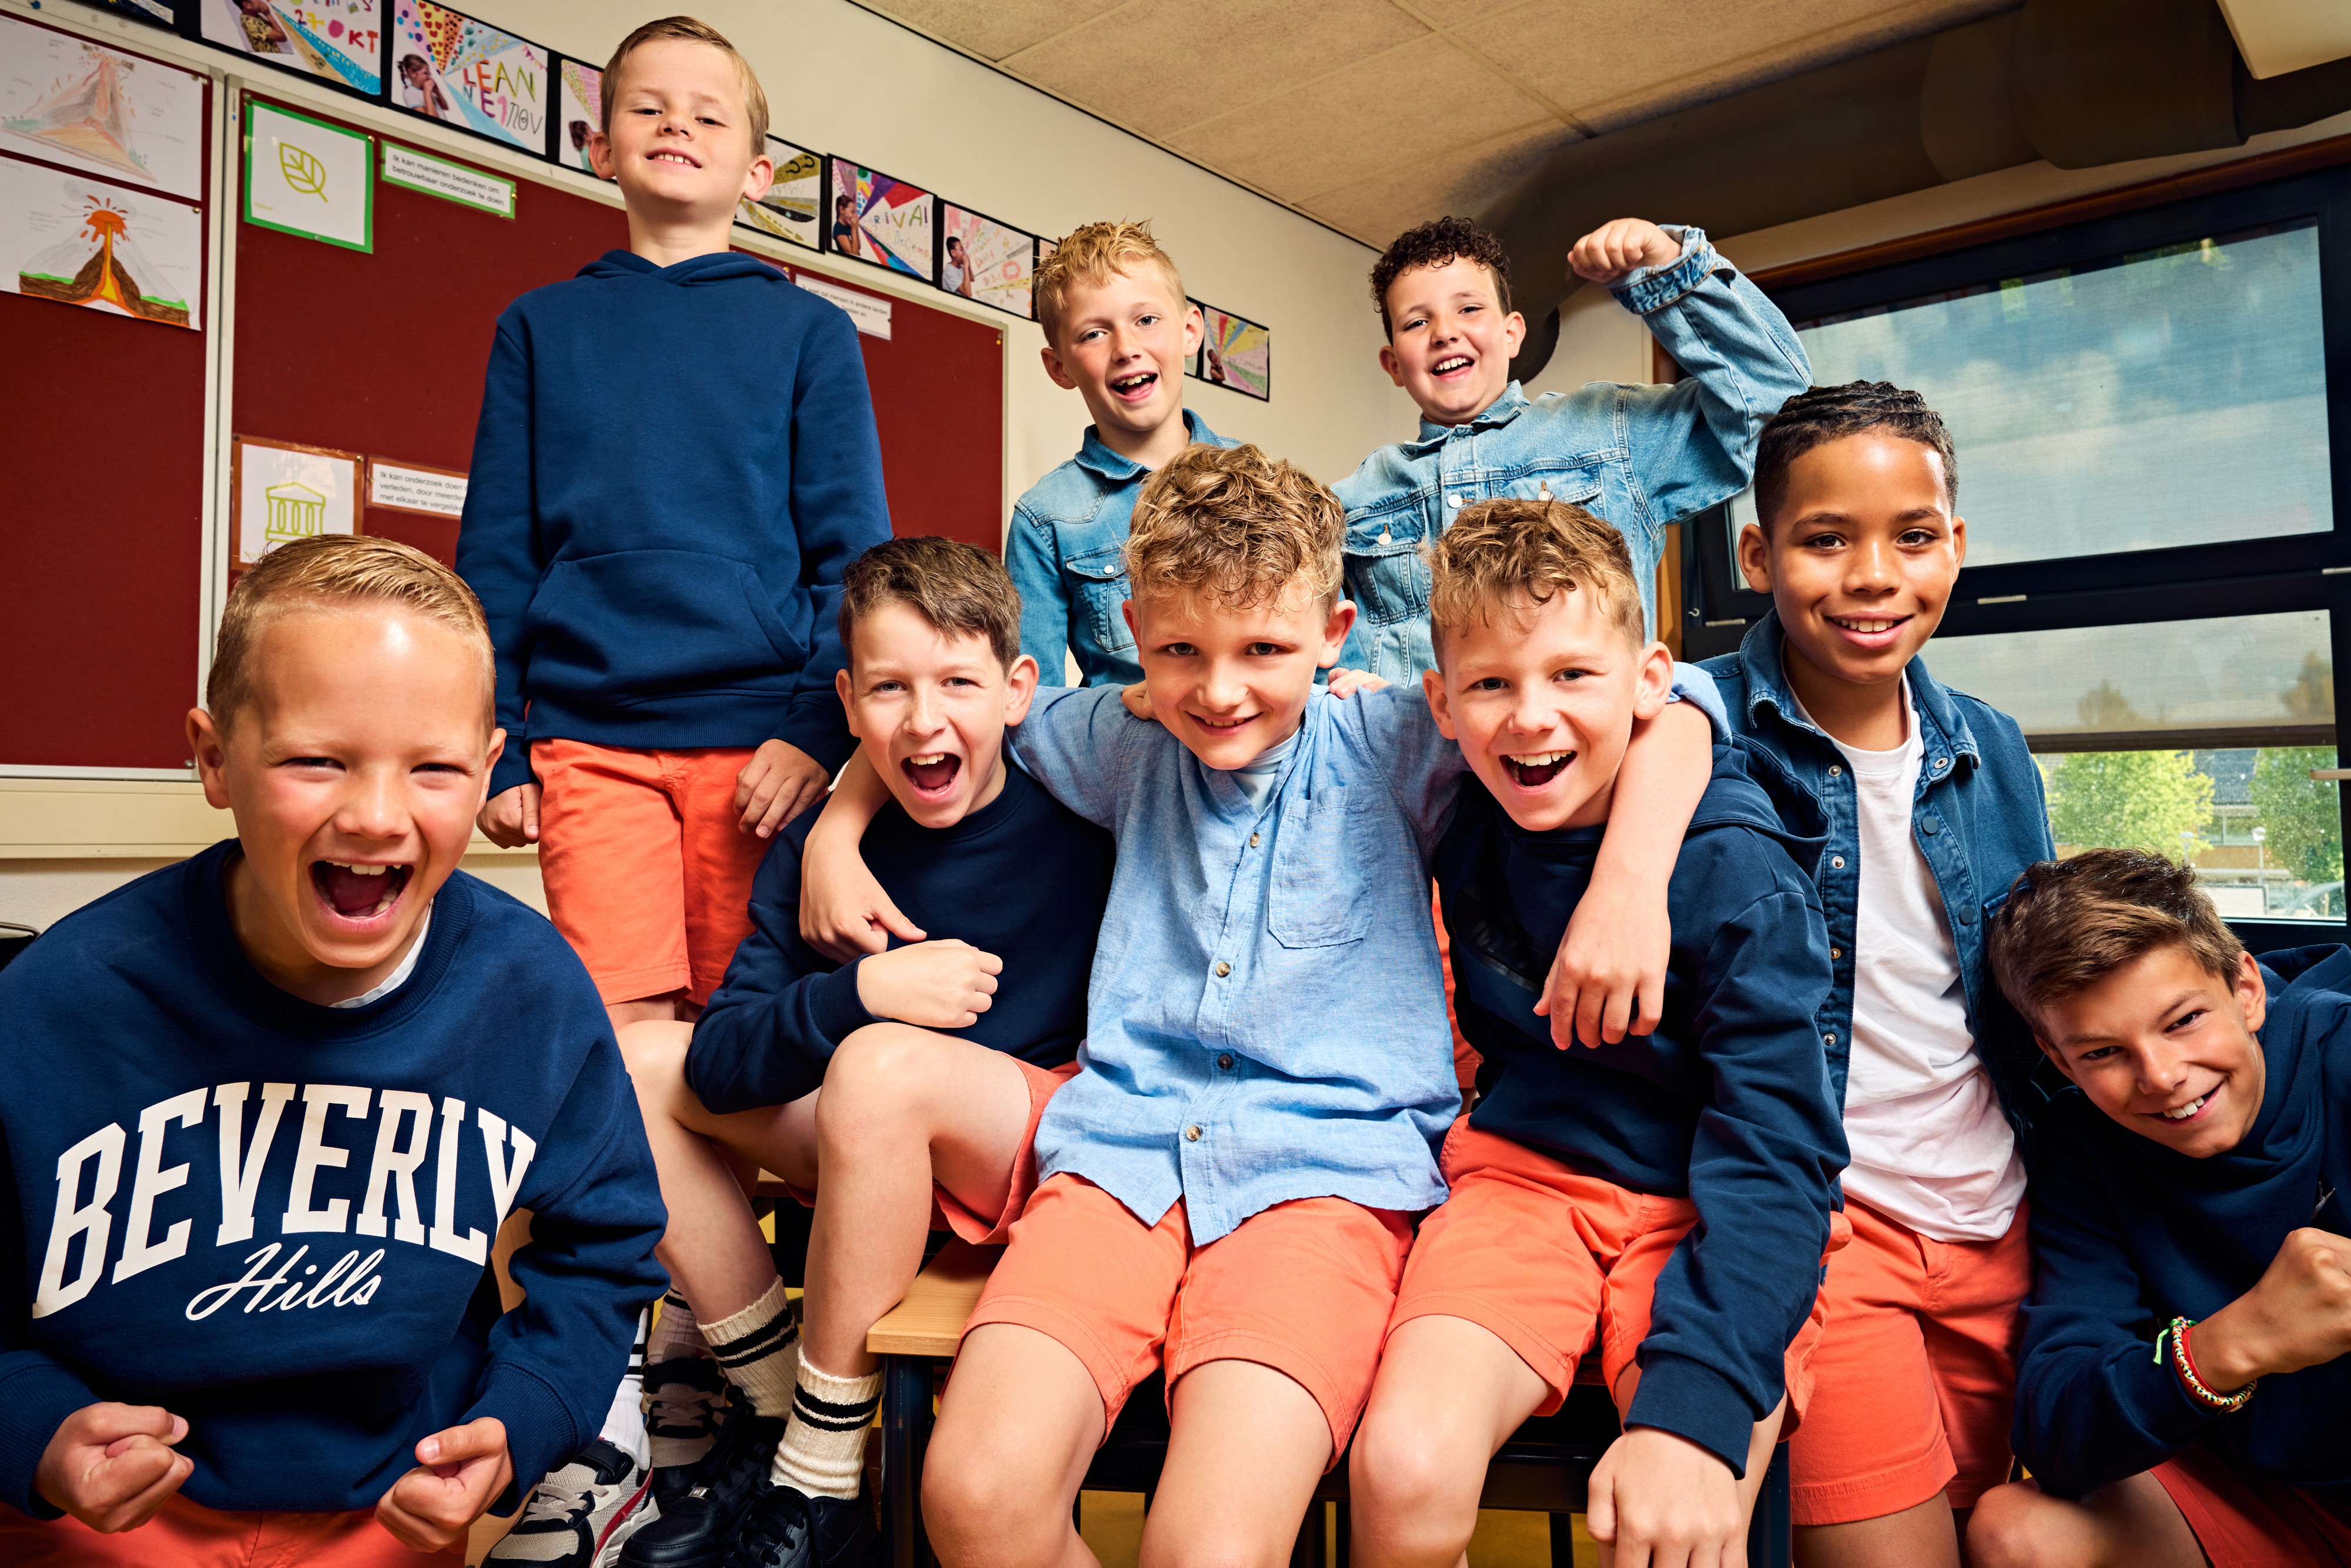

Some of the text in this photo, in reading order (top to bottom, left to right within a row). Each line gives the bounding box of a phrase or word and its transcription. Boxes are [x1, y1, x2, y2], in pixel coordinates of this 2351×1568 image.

[393, 155, 400, 163] Ik
[401, 157, 415, 167] kan
[417, 163, 451, 177] manieren
[453, 174, 487, 189] bedenken
[393, 165, 438, 185] betrouwbaar
[440, 180, 477, 197] onderzoek
[478, 192, 485, 200] te
[389, 473, 403, 481] kan
[404, 475, 443, 487] onderzoek
[444, 483, 463, 491] doen
[416, 488, 433, 497] door
[435, 492, 465, 501] meerder
[396, 496, 418, 505] elkaar
[32, 1081, 537, 1320] BEVERLY
[186, 1242, 386, 1322] Hills
